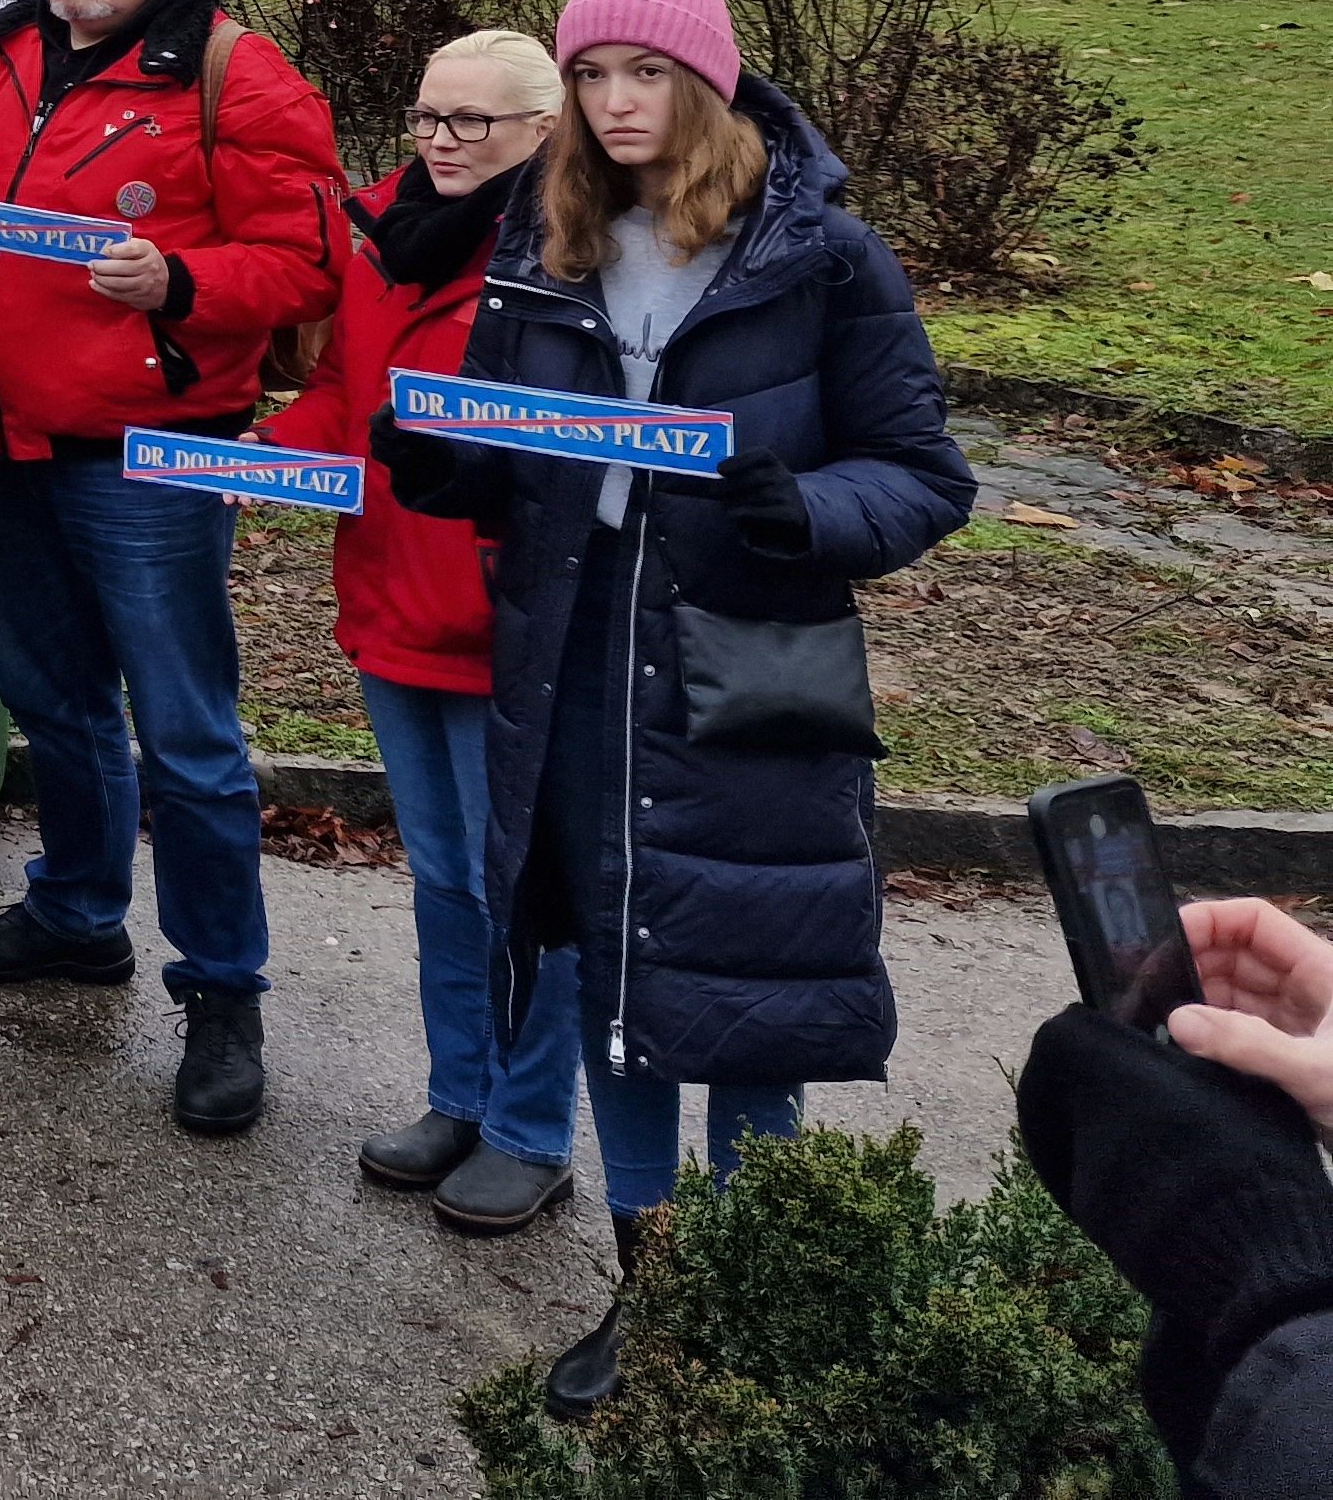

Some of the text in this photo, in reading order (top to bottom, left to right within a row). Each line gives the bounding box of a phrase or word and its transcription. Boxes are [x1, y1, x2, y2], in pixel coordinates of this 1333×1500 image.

[45, 230, 114, 254] PLATZ
[407, 389, 711, 458] DR. DOLLFUSS PLATZ
[136, 444, 348, 495] DR. DOLLFUSS PLATZ
